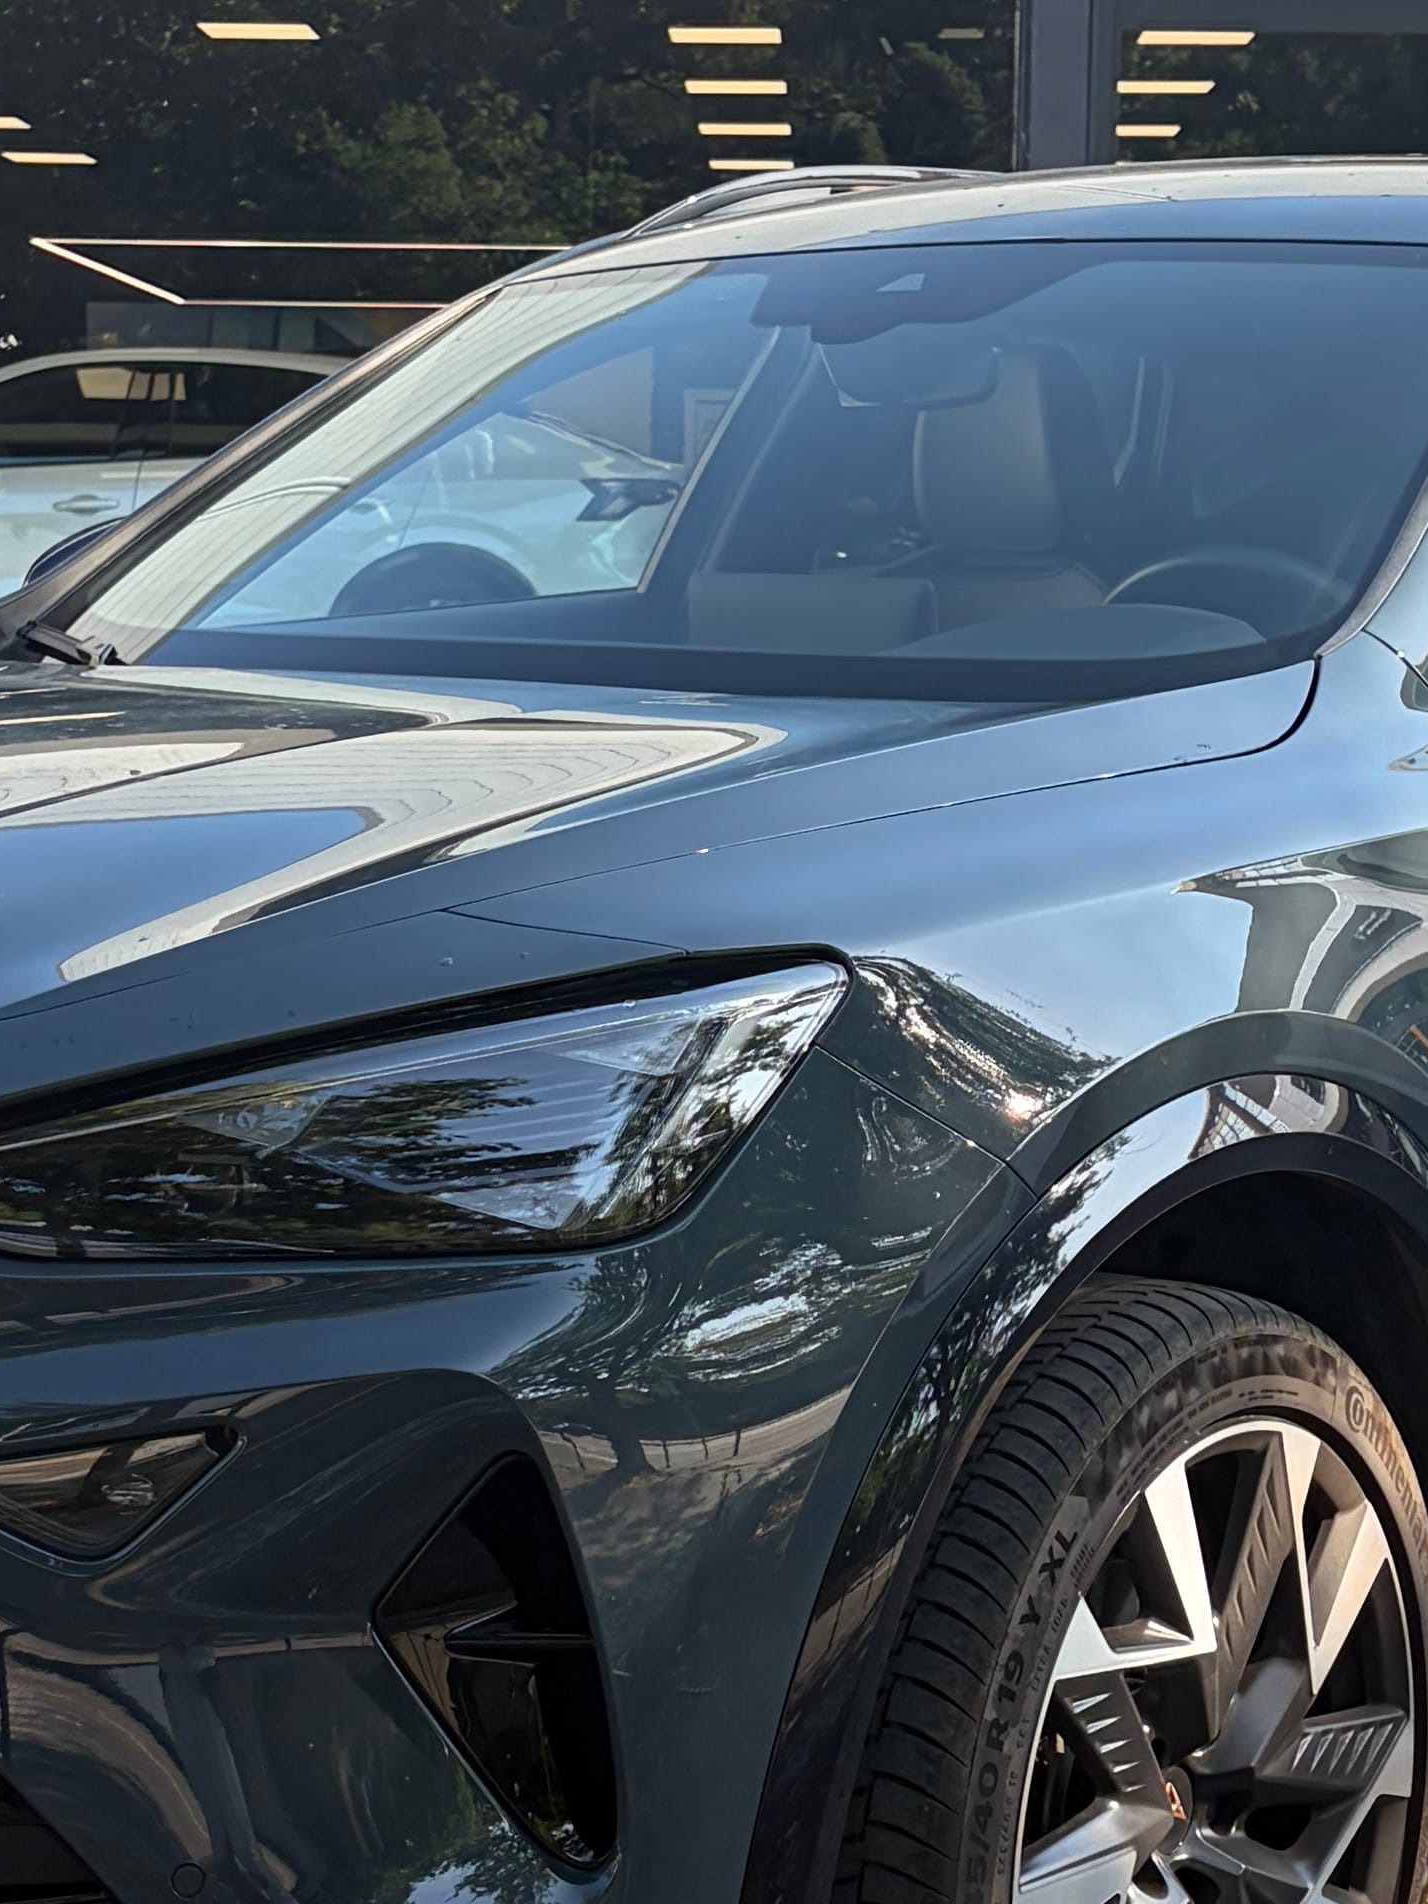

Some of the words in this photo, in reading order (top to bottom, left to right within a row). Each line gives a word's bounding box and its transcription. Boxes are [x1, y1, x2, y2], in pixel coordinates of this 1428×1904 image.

[1344, 1385, 1428, 1556] Continental
[986, 1717, 1010, 1752] R
[998, 1648, 1025, 1704] 19
[1019, 1594, 1041, 1627] Y
[1038, 1530, 1078, 1587] XL
